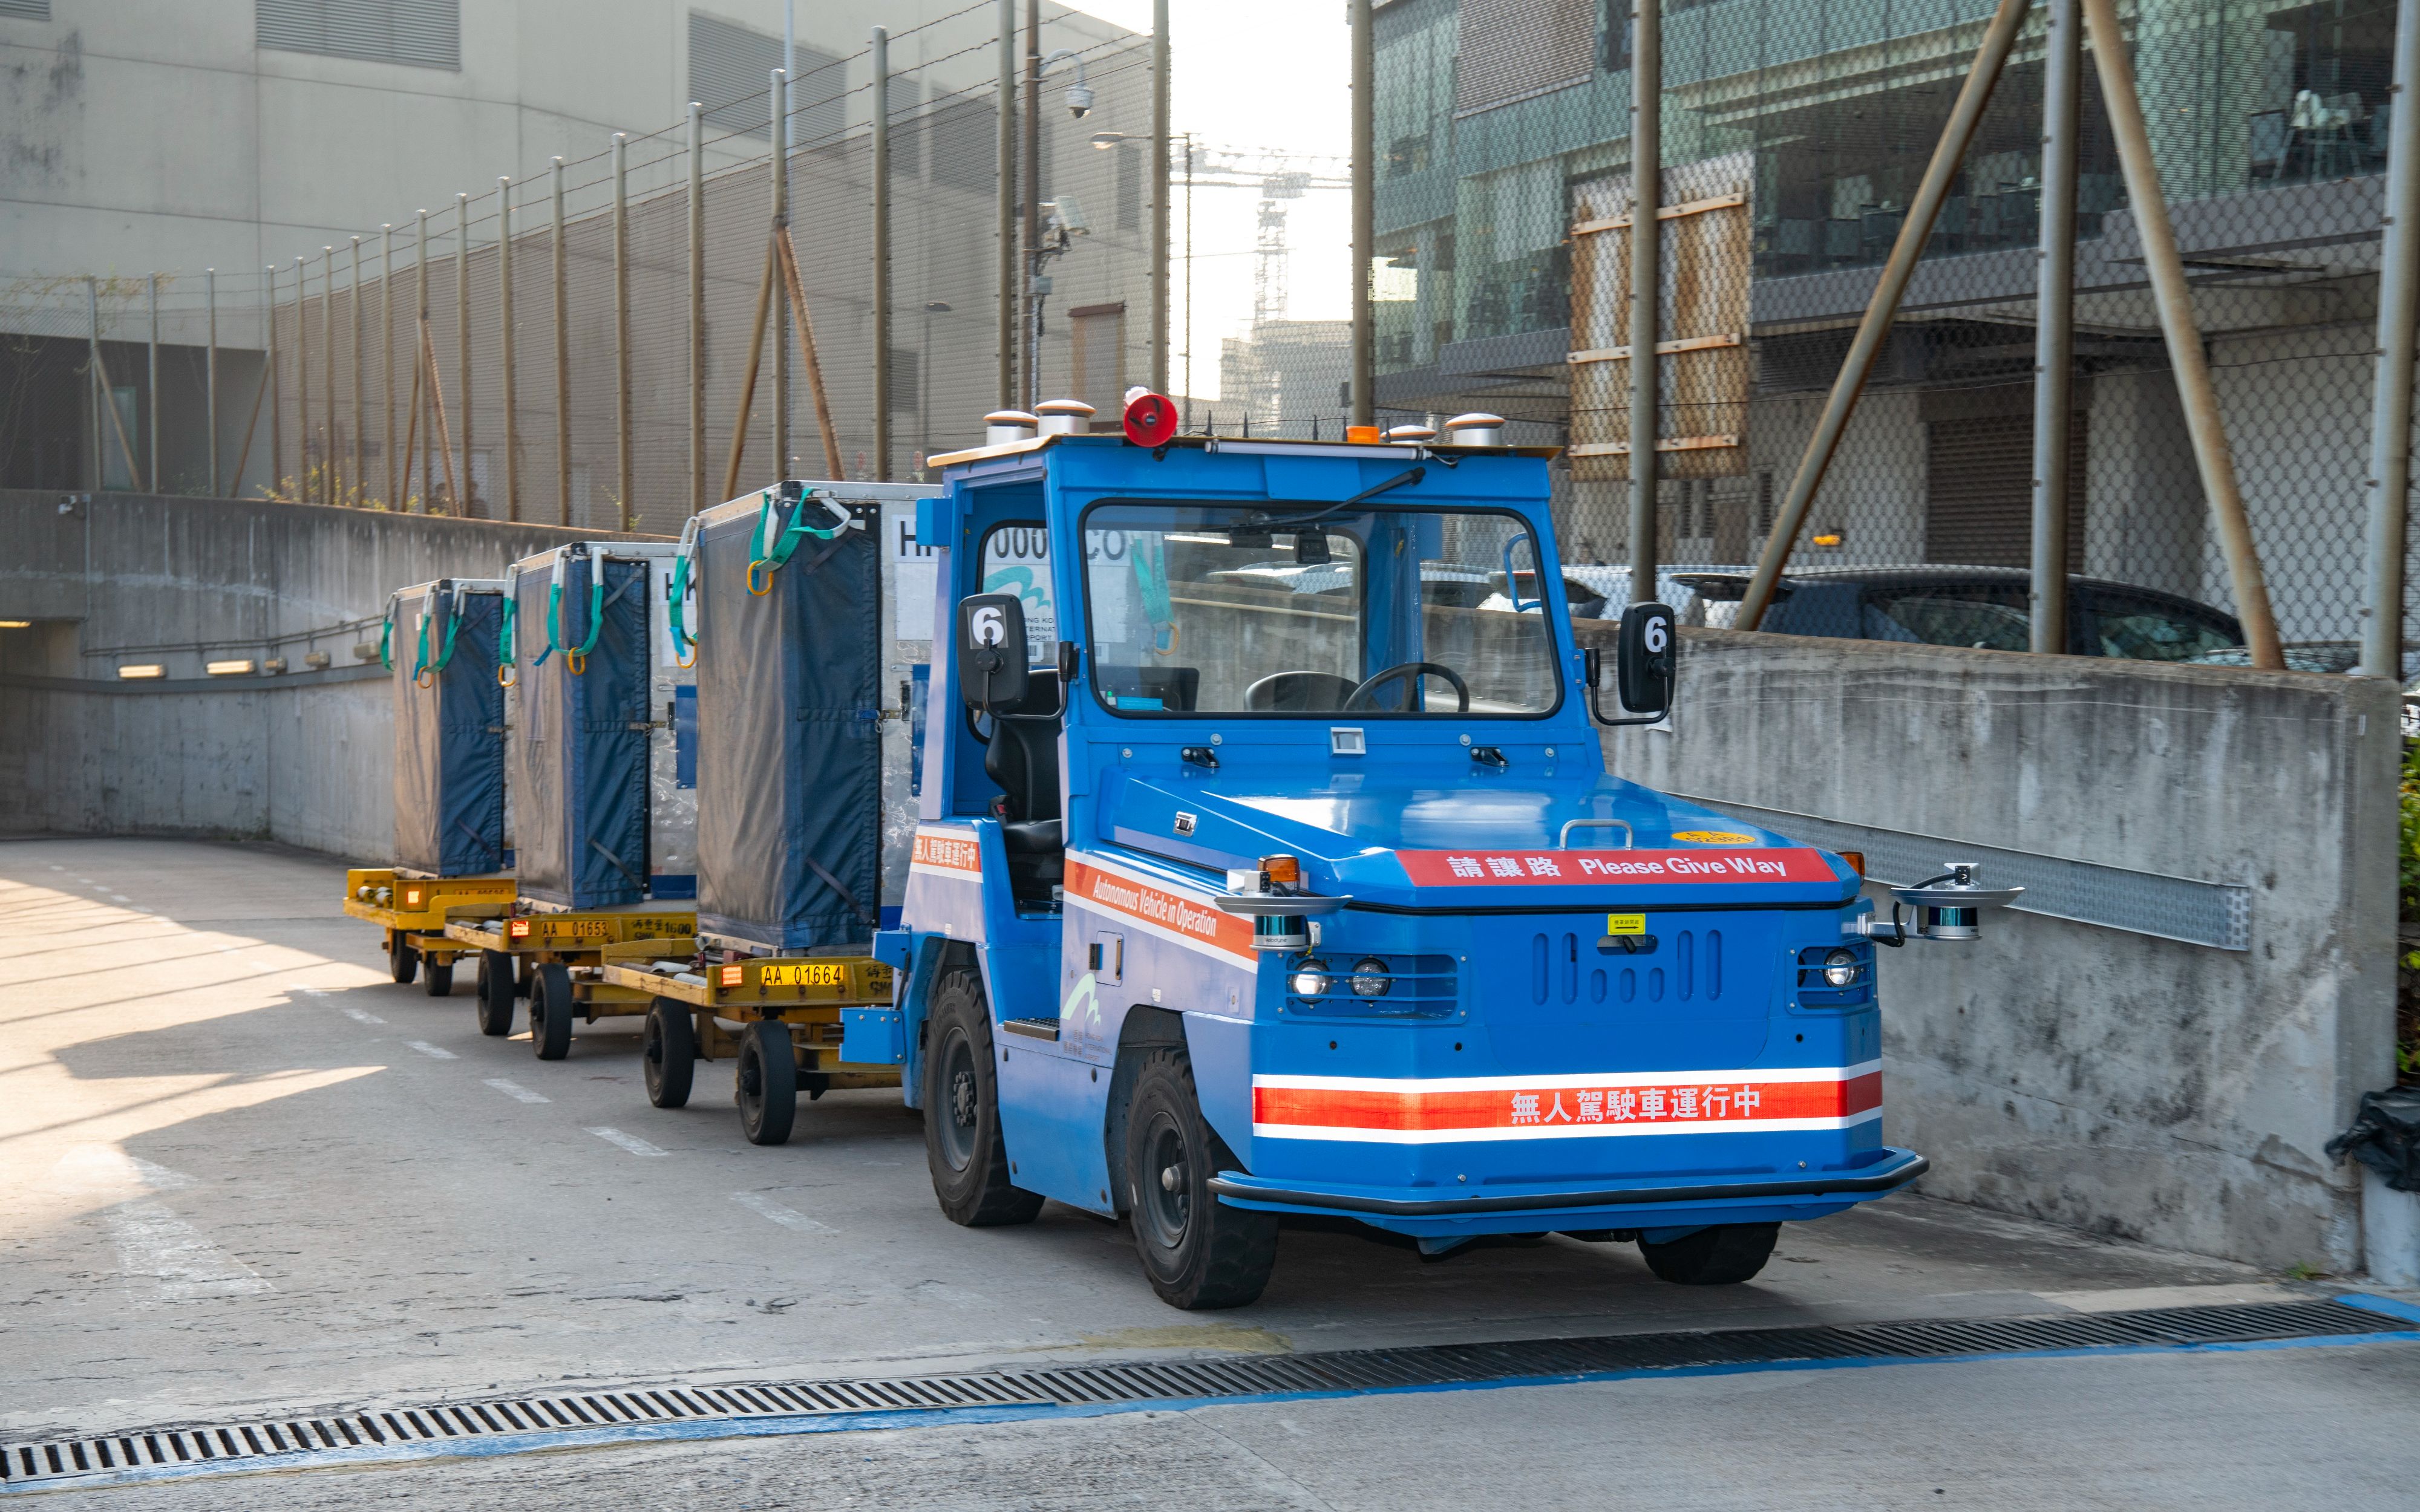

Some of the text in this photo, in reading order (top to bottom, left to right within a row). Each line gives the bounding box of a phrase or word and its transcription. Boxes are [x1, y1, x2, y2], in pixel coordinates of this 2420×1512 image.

[972, 607, 1004, 645] 6
[1644, 616, 1667, 653] 6
[1446, 856, 1787, 878] 請讓路 Please Give Way
[1093, 875, 1217, 937] Autonomous Vehicle in Operation
[543, 922, 608, 936] AA 01653
[764, 966, 841, 985] AA 01664
[1511, 1084, 1760, 1124] 無人駕駛車運行中
